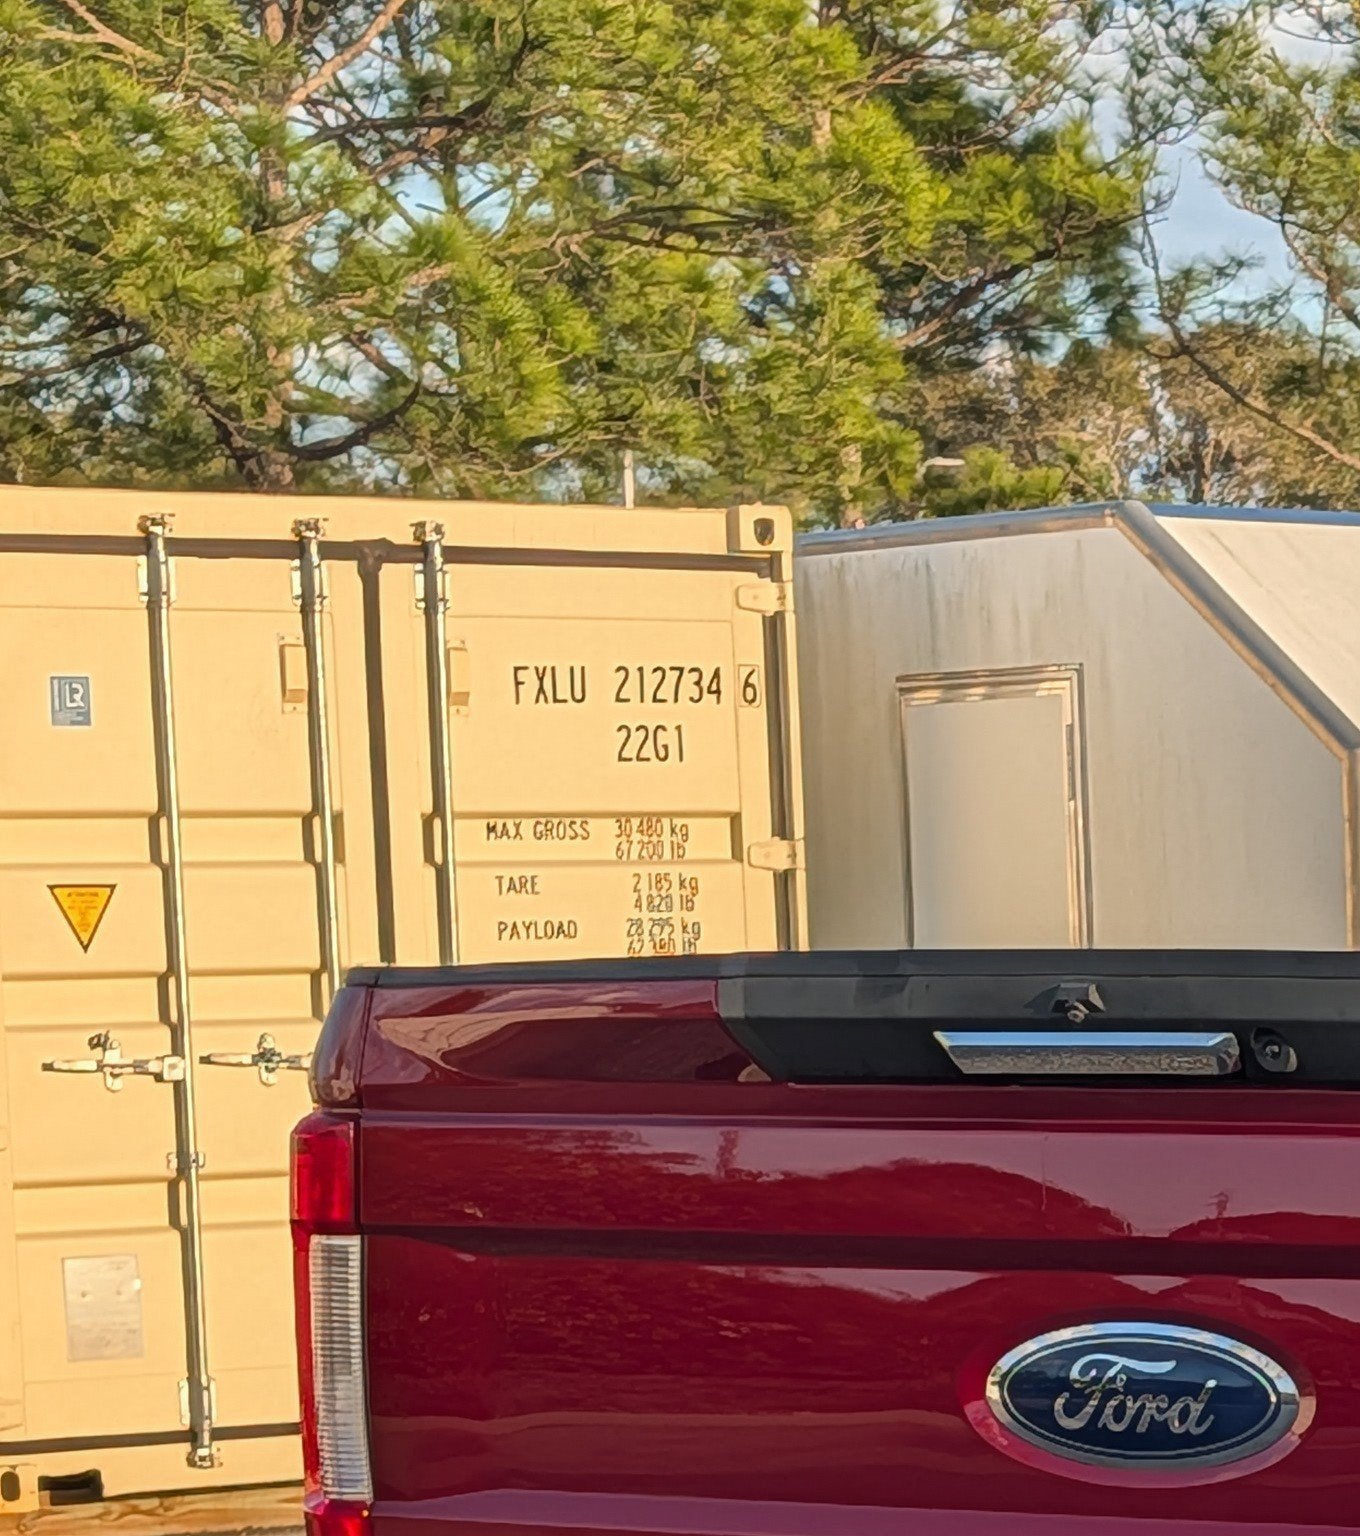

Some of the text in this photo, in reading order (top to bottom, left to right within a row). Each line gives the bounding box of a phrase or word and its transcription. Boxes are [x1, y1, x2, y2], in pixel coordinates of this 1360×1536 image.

[513, 665, 757, 704] FXLU 212734 6
[616, 724, 684, 762] 22G1
[486, 820, 523, 841] MAX
[533, 819, 590, 840] GROSS
[669, 817, 689, 842] kg
[494, 875, 541, 896] TARE
[679, 872, 699, 897] kg
[497, 920, 578, 940] PAYLOAD
[681, 917, 701, 941] kg
[1053, 1353, 1217, 1435] Ford
